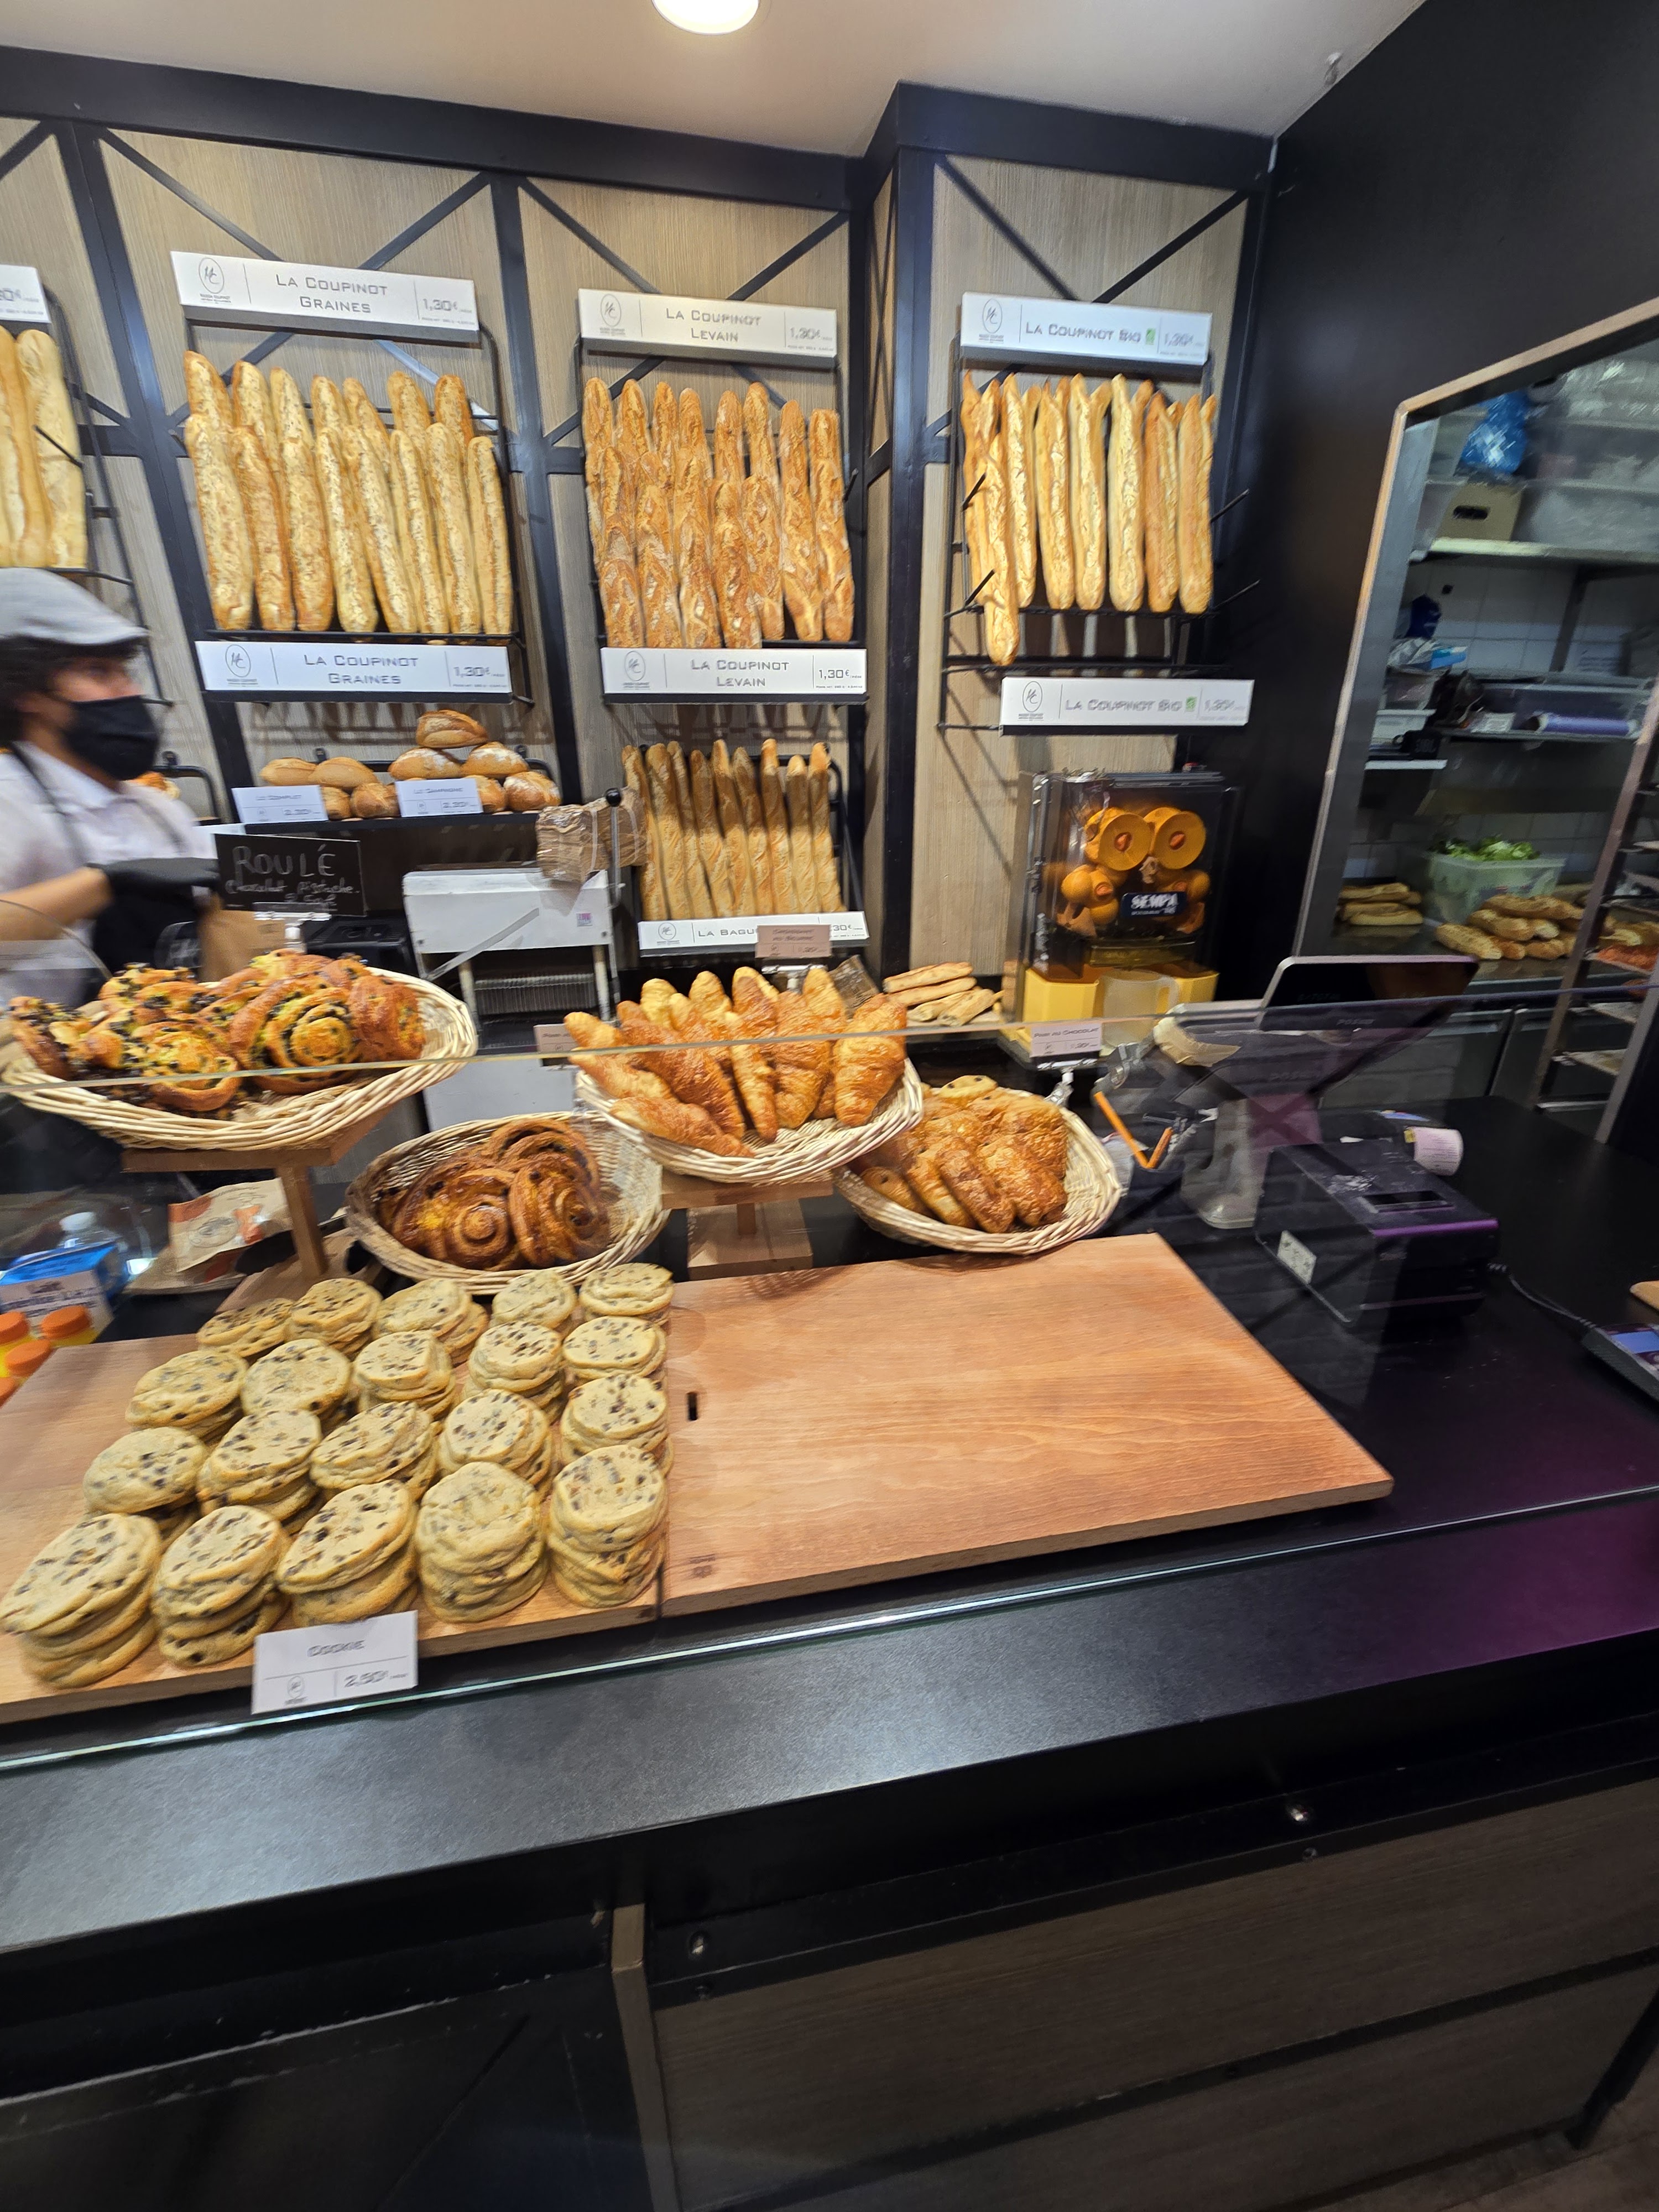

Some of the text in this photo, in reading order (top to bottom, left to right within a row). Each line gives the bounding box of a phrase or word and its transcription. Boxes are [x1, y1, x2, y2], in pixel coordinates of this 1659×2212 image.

[275, 274, 388, 295] LA COUPINOT
[300, 296, 371, 313] GRAINES
[666, 307, 761, 326] LA COUPINOT
[691, 327, 738, 342] LEVAIN
[1026, 322, 1043, 335] LA
[1048, 324, 1115, 341] COUPINOT
[304, 654, 419, 667] LA COUPINOT
[692, 659, 790, 671] LA COUPINOT
[328, 673, 401, 685] GRAINES
[717, 676, 766, 687] LEVAIN
[1065, 699, 1083, 711] LA
